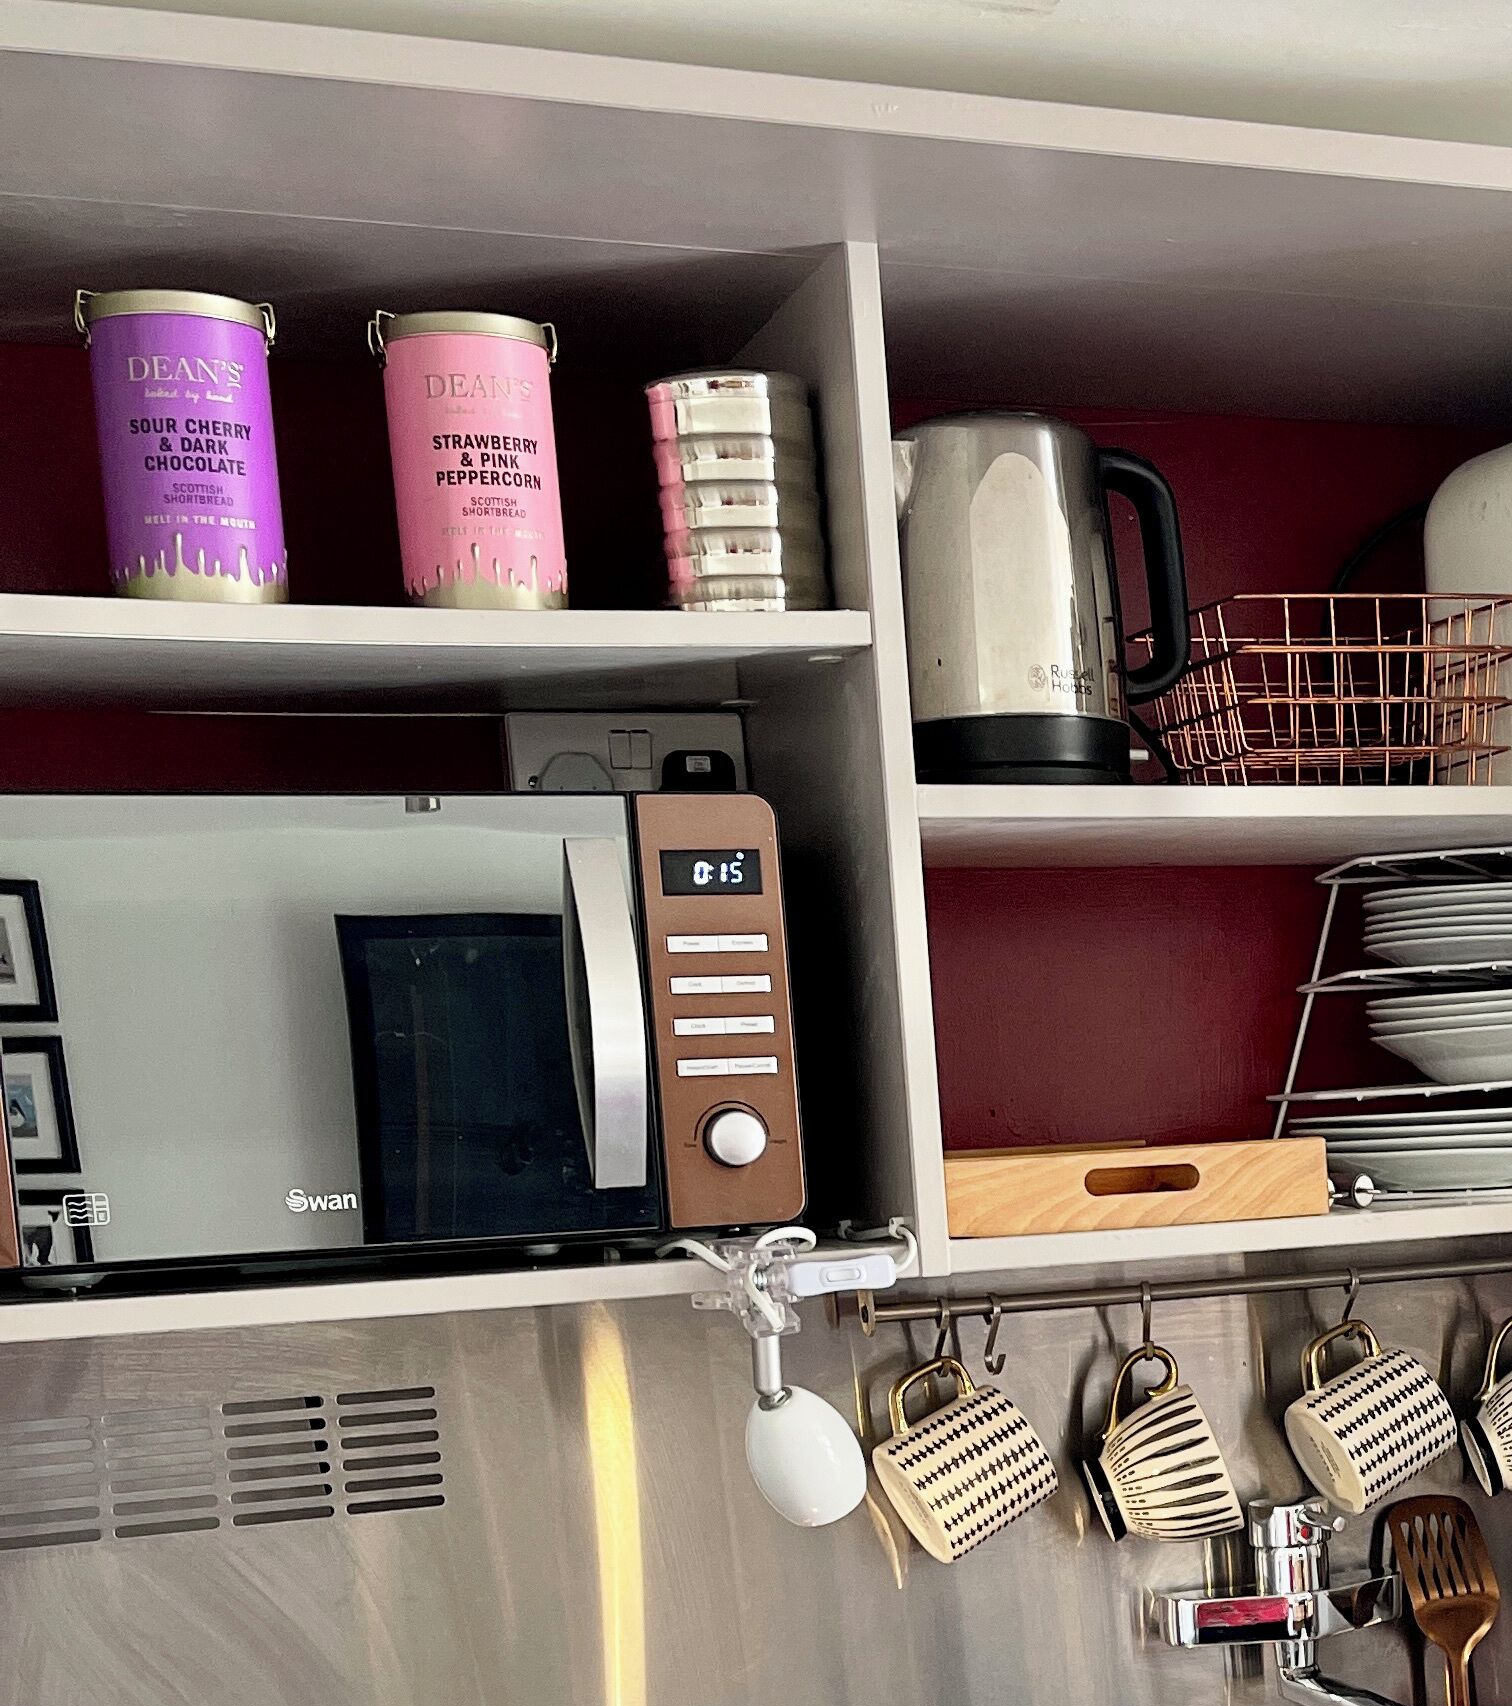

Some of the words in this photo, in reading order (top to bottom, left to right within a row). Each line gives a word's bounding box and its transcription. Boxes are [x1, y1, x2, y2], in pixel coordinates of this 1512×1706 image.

[127, 355, 244, 389] DEAN'S
[424, 373, 533, 401] DEAN'S
[129, 417, 178, 435] SOUR
[185, 418, 251, 440] CHERRY
[159, 436, 173, 453] &
[180, 437, 228, 456] DARK
[432, 434, 538, 455] STRAWBERRY
[144, 455, 247, 477] CHOCOLATE
[460, 452, 474, 467] &
[480, 452, 520, 470] PINK
[172, 482, 224, 495] SCOTTISH
[436, 470, 541, 490] PEPPERCORN
[163, 494, 234, 507] SHORTBREAD
[470, 496, 518, 508] SCOTTISH
[193, 515, 215, 526] THE
[462, 506, 527, 519] SHORTBREAD
[1050, 664, 1095, 683] Russell
[1051, 680, 1093, 696] Hobbs
[693, 861, 744, 886] 0:15
[285, 1188, 358, 1213] Swan
